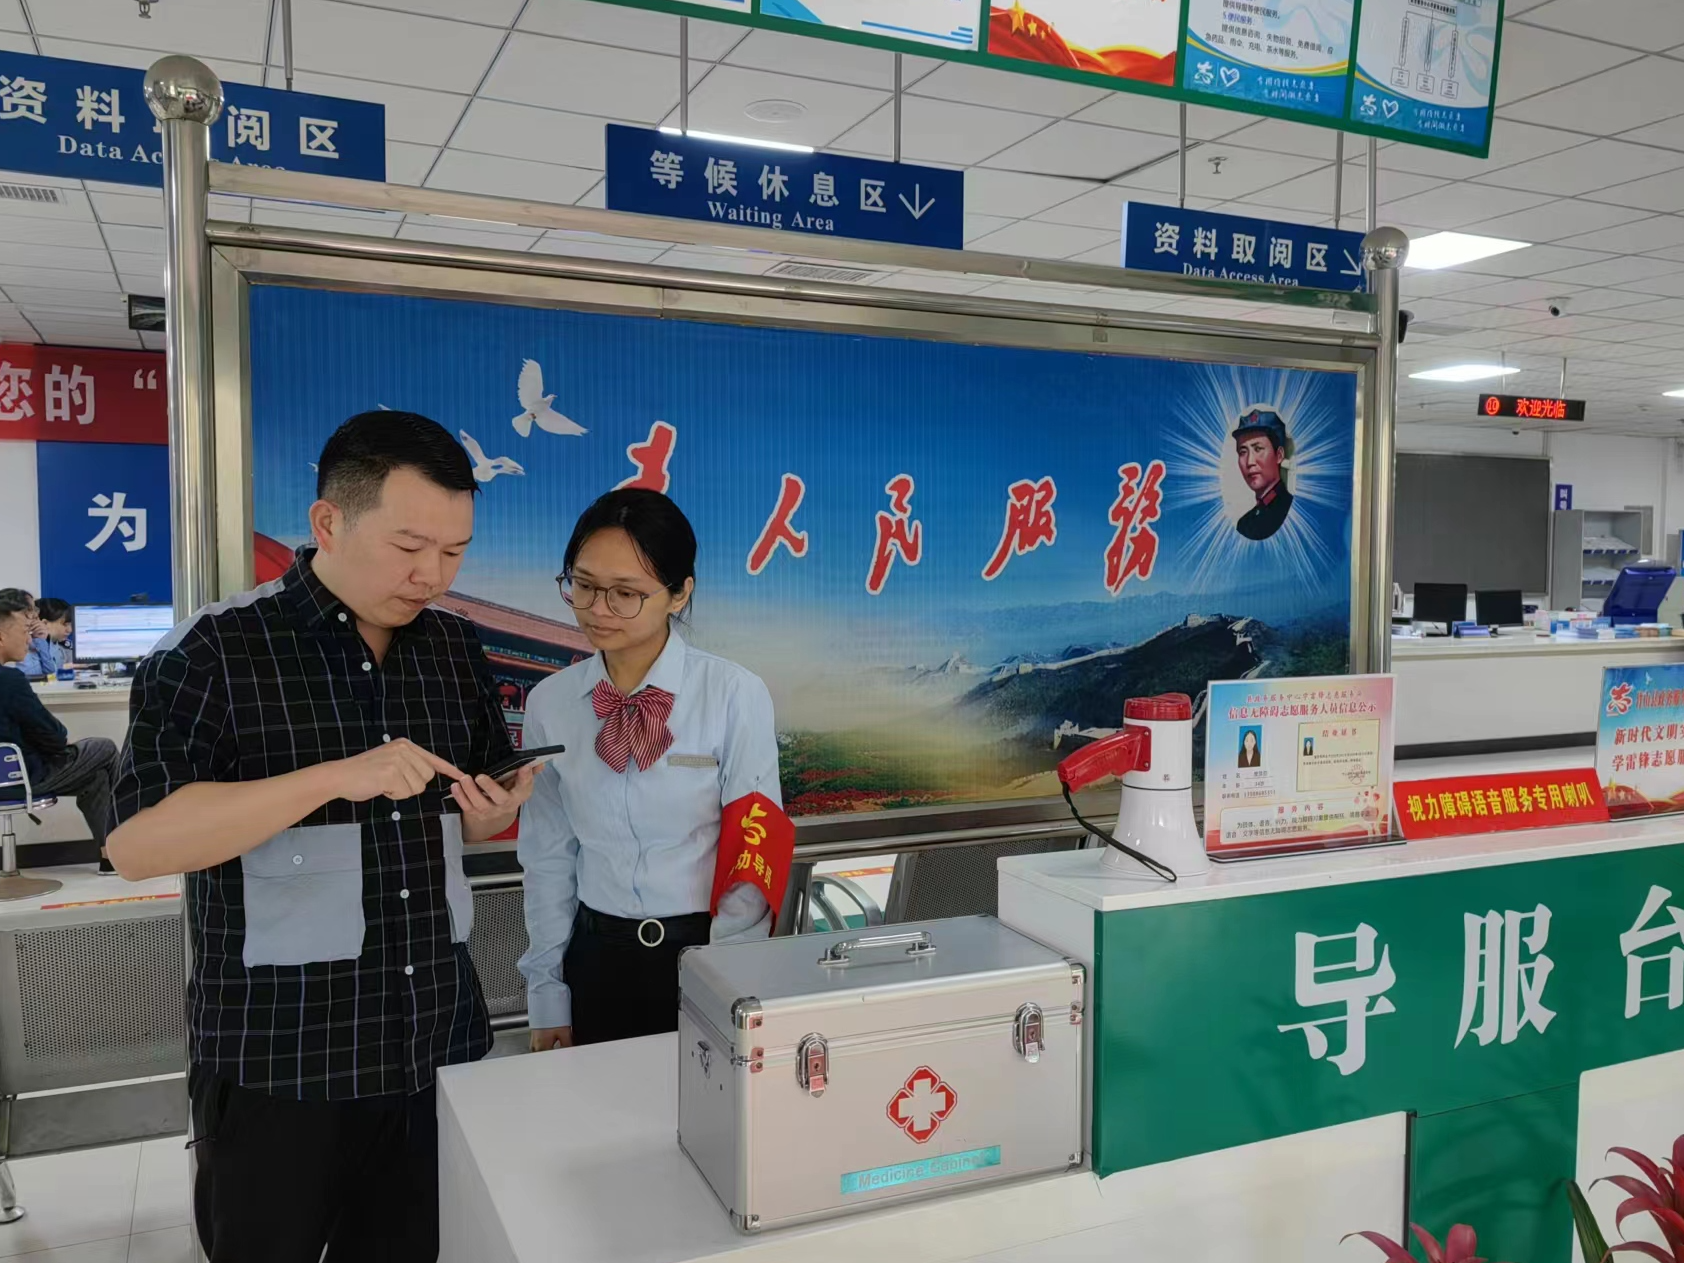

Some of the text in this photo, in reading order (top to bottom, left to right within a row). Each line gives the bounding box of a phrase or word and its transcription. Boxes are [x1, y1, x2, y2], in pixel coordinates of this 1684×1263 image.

[0, 75, 340, 159] 资料阅区
[57, 134, 123, 161] Data
[649, 149, 887, 214] 等候休息区
[707, 200, 835, 232] Waiting Area
[1154, 221, 1329, 272] 资料取阅区
[1182, 262, 1299, 286] Data Access Area
[1515, 398, 1567, 418] 欢迎光临
[84, 491, 148, 553] 为
[1407, 781, 1595, 823] 视力障碍语音服务专用喇叭
[1277, 884, 1684, 1077] 导服台
[857, 1164, 925, 1189] Medicine
